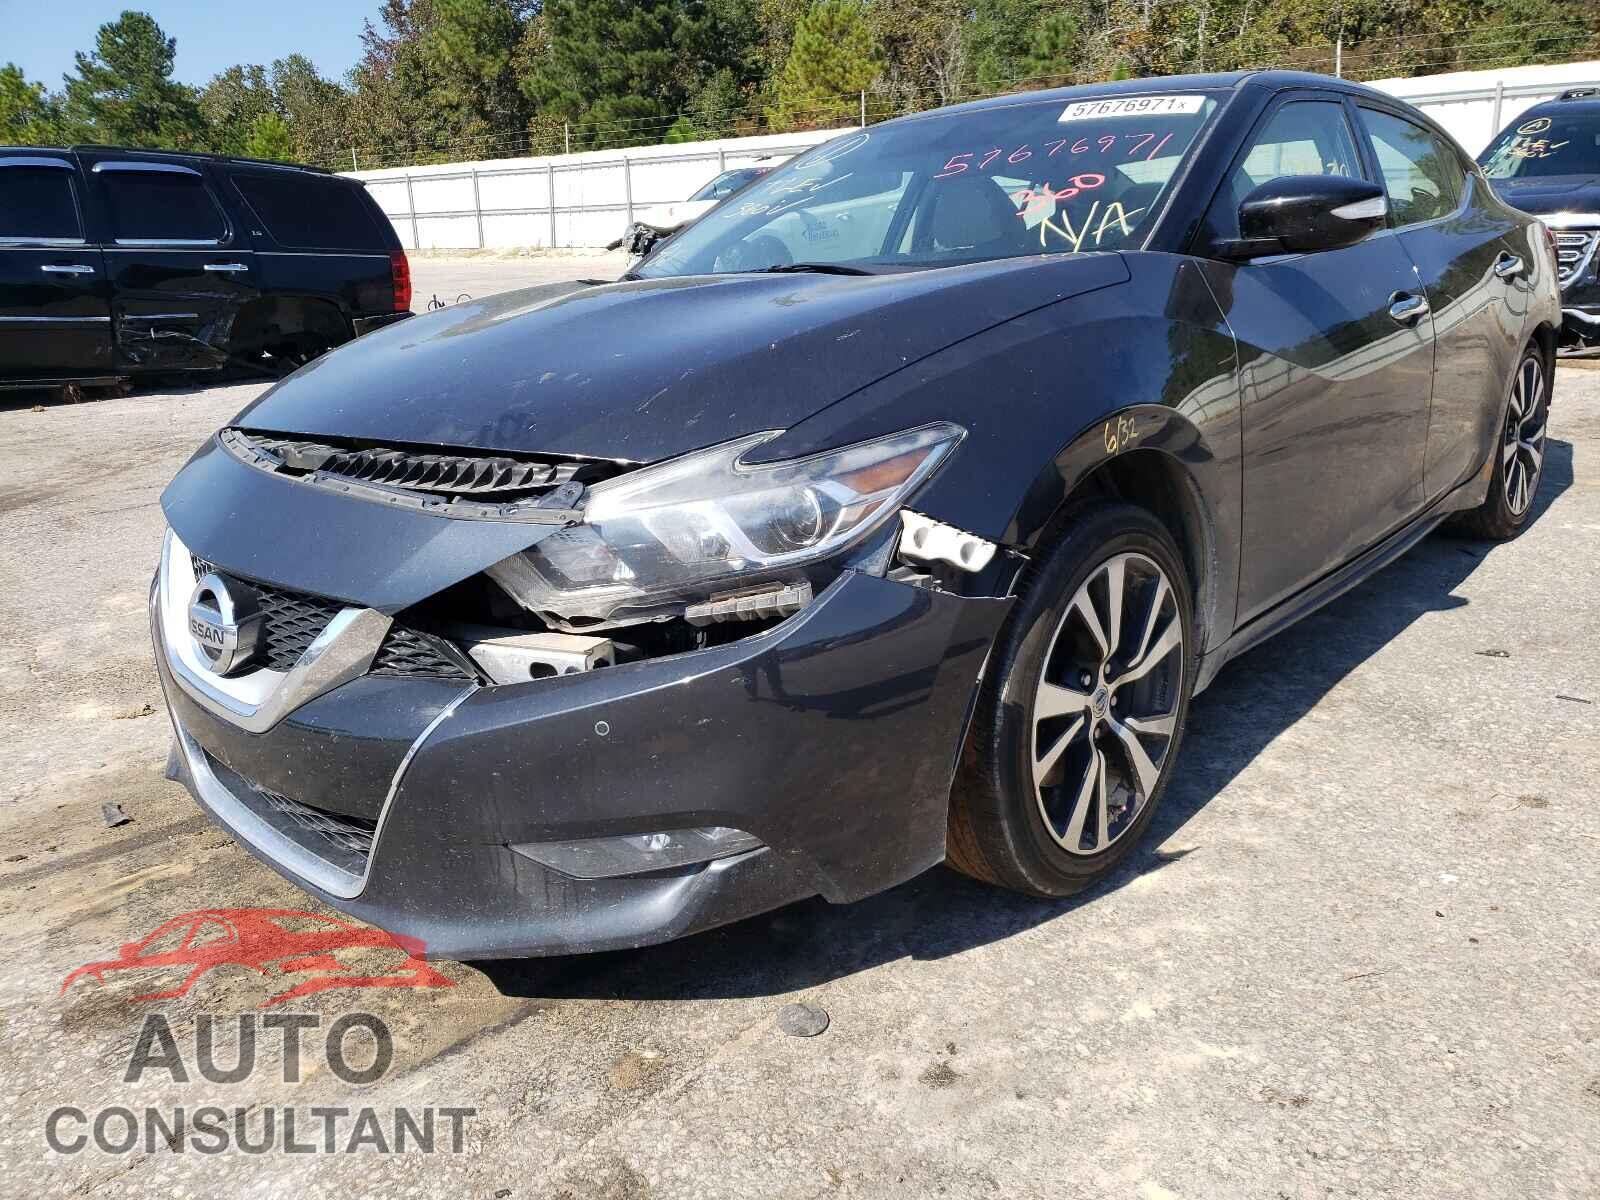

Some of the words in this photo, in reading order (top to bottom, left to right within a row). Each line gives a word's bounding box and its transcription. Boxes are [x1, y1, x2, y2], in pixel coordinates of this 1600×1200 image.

[933, 132, 1174, 178] 57676971
[1040, 200, 1146, 253] N/A
[1104, 415, 1140, 456] 6/32
